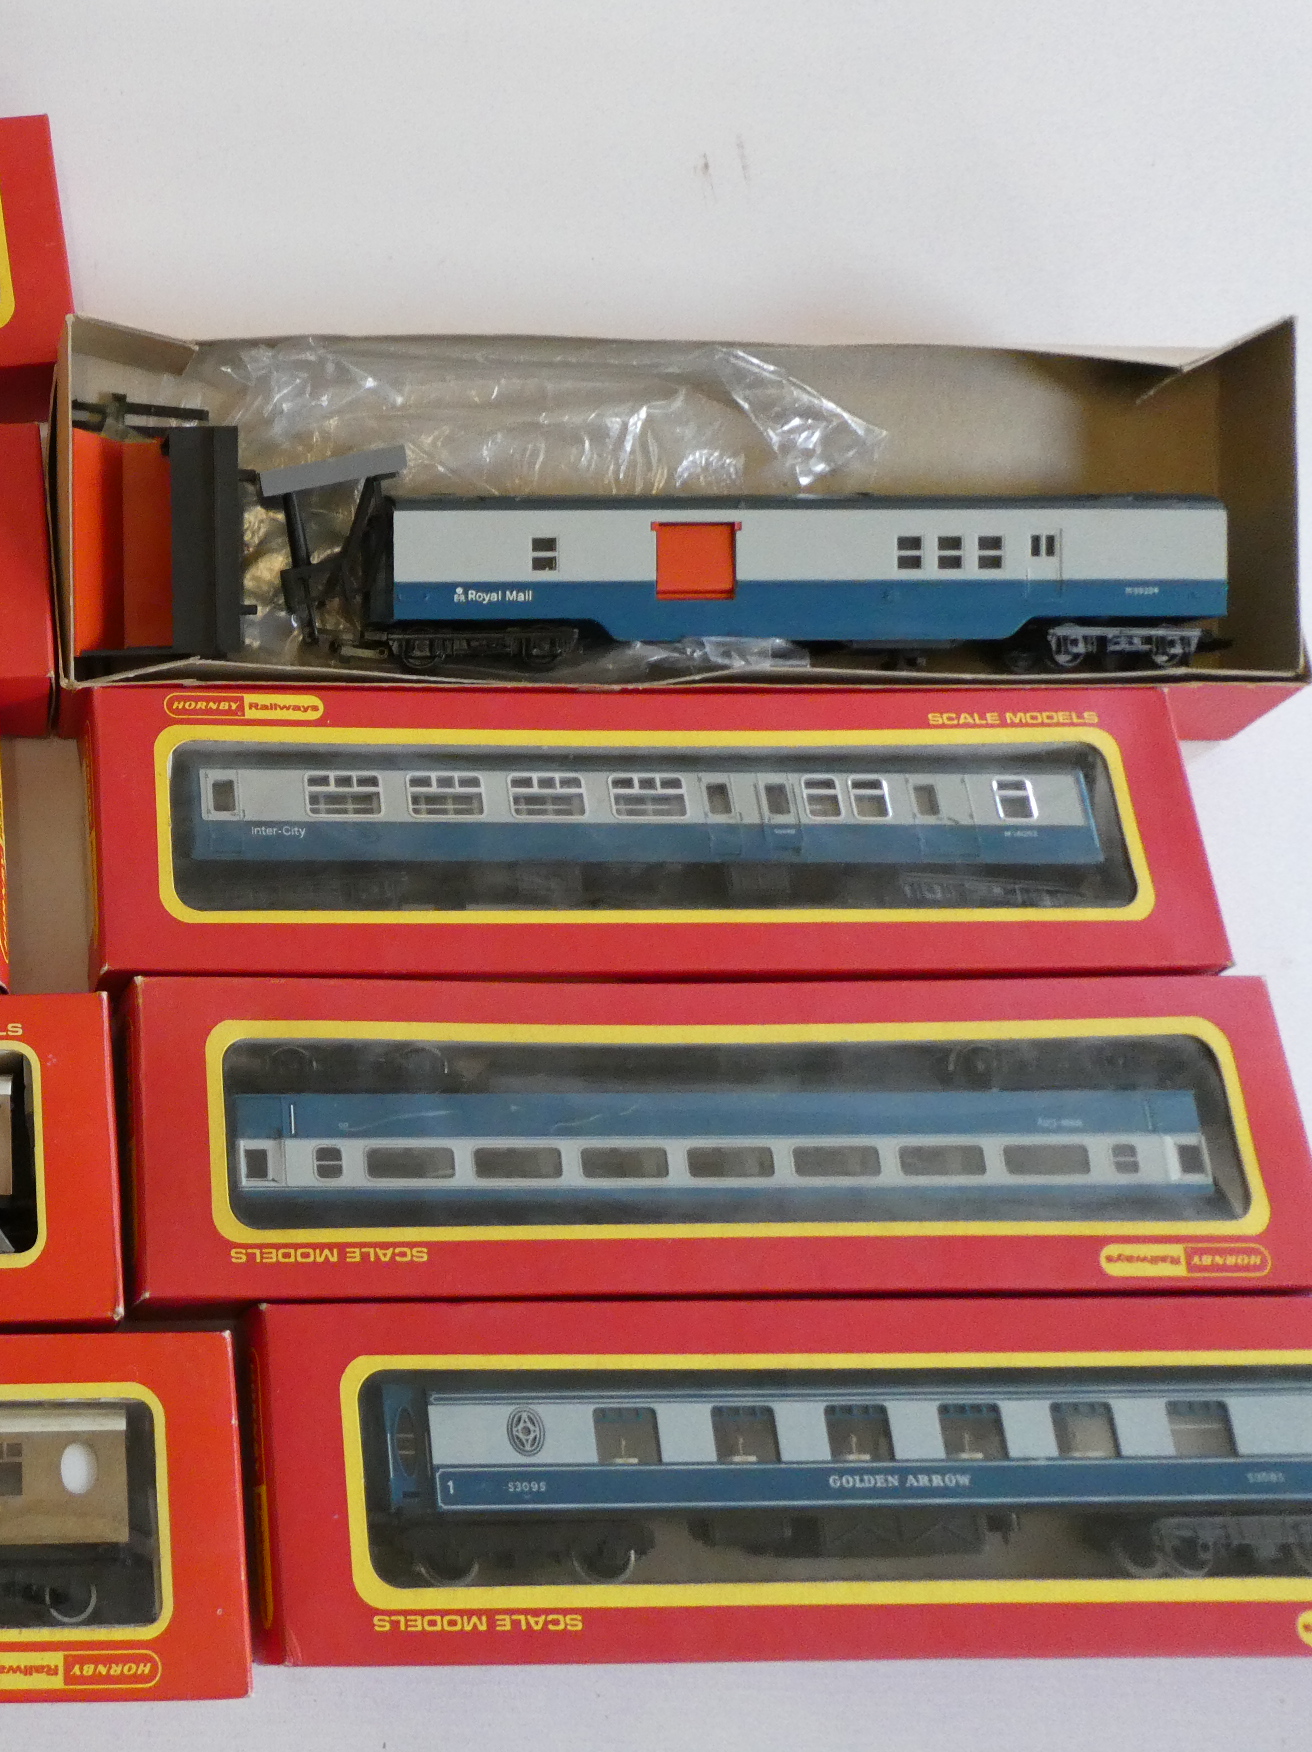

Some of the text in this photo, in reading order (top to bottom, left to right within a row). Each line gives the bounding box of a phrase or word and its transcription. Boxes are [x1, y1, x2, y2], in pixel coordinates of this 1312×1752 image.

[468, 589, 532, 604] Royal Mail
[172, 700, 320, 713] HORNBY Railways
[928, 711, 1099, 725] SCALE MODELS
[251, 826, 306, 838] Inter-City
[230, 1247, 428, 1263] SCALE MODELS
[829, 1473, 971, 1488] GOLDEN ARROW
[373, 1614, 583, 1631] SCALE MODELS
[70, 1662, 152, 1676] HORNBY
